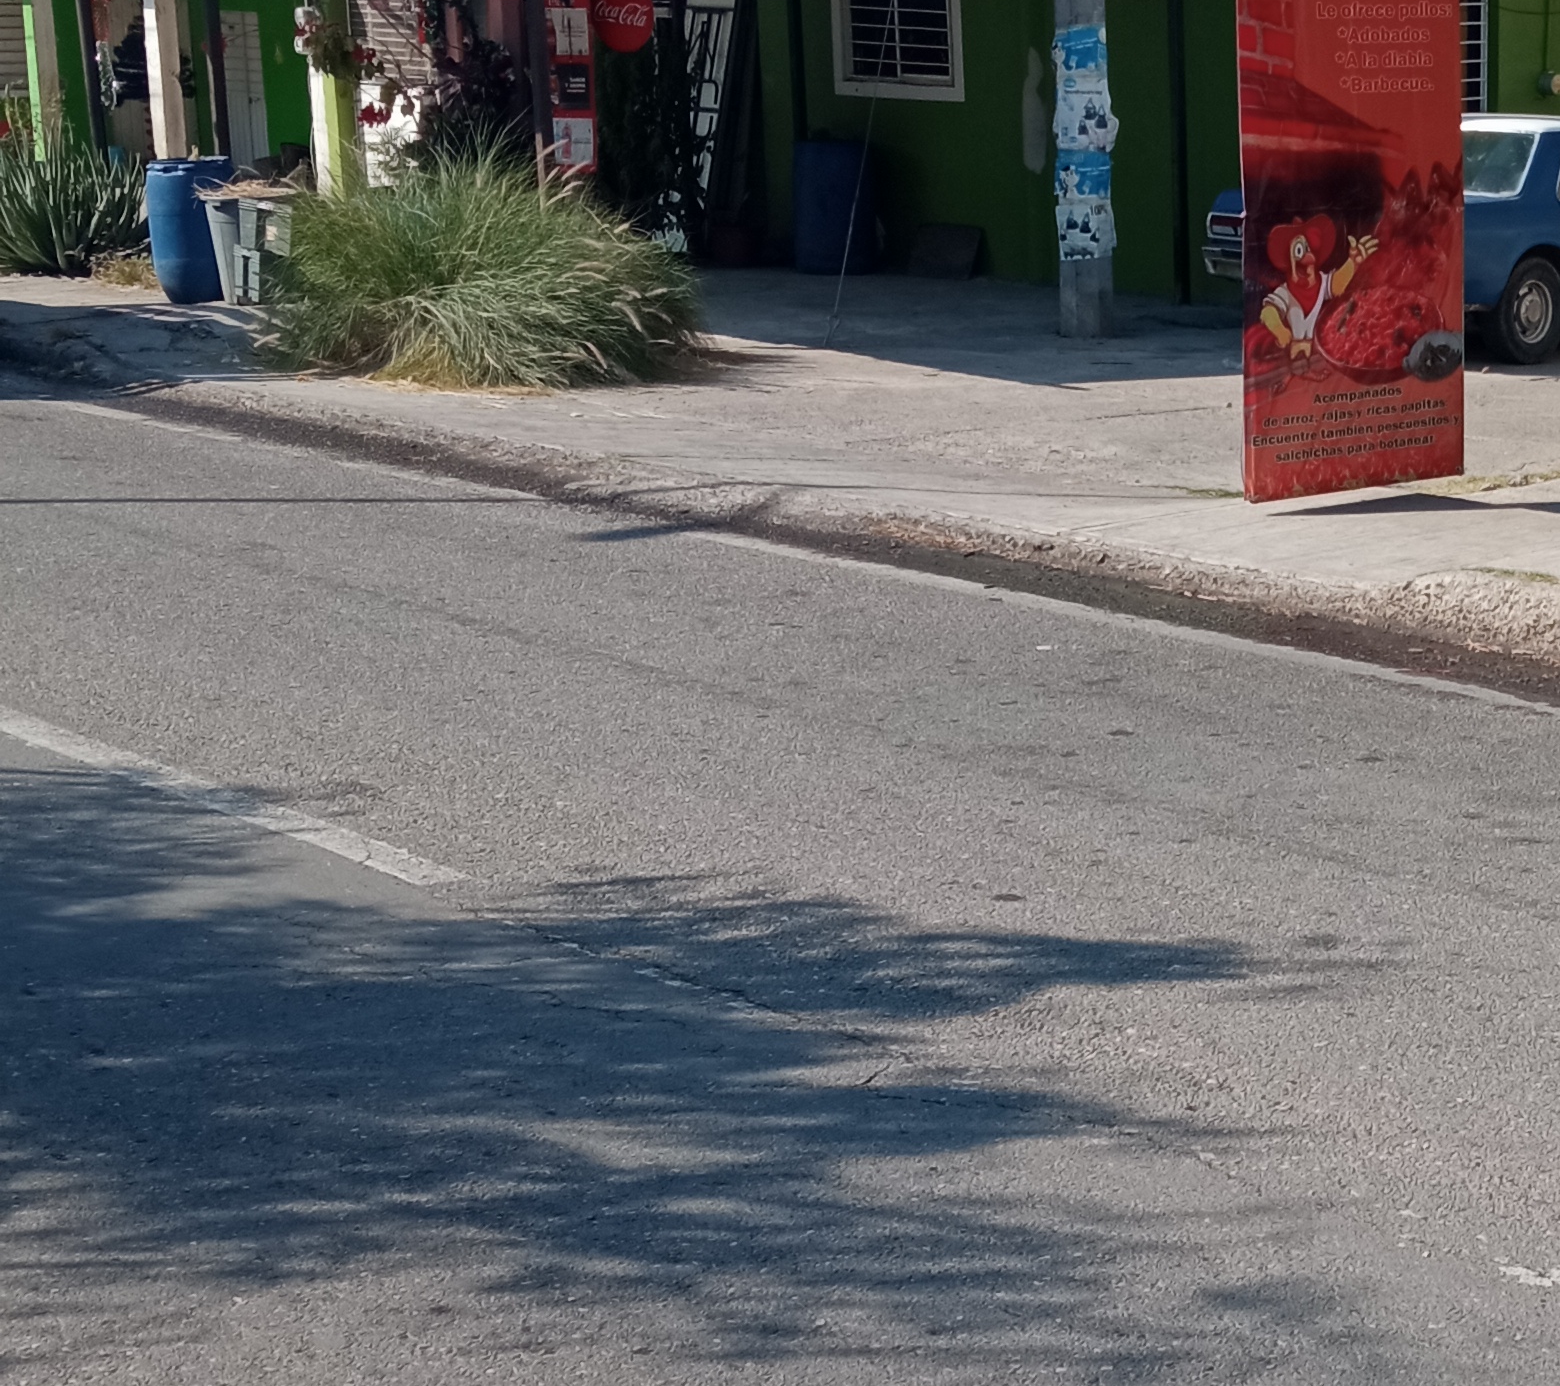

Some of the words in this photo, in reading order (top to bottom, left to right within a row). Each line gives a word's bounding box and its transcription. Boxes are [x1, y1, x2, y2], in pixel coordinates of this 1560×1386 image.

[1316, 1, 1338, 19] Le
[1341, 0, 1396, 19] ofrece
[1398, 0, 1453, 21] pollos:
[1361, 50, 1379, 68] la
[1381, 49, 1434, 68] diabla
[1313, 385, 1403, 405] Acompañados
[1263, 416, 1279, 428] de
[1321, 408, 1354, 423] rajas
[1366, 404, 1398, 417] ricas
[1251, 431, 1318, 448] Encuentre
[1320, 424, 1373, 440] tambien
[1275, 445, 1344, 463] salchichas
[1347, 442, 1376, 456] para
[1379, 435, 1435, 450] botanear
